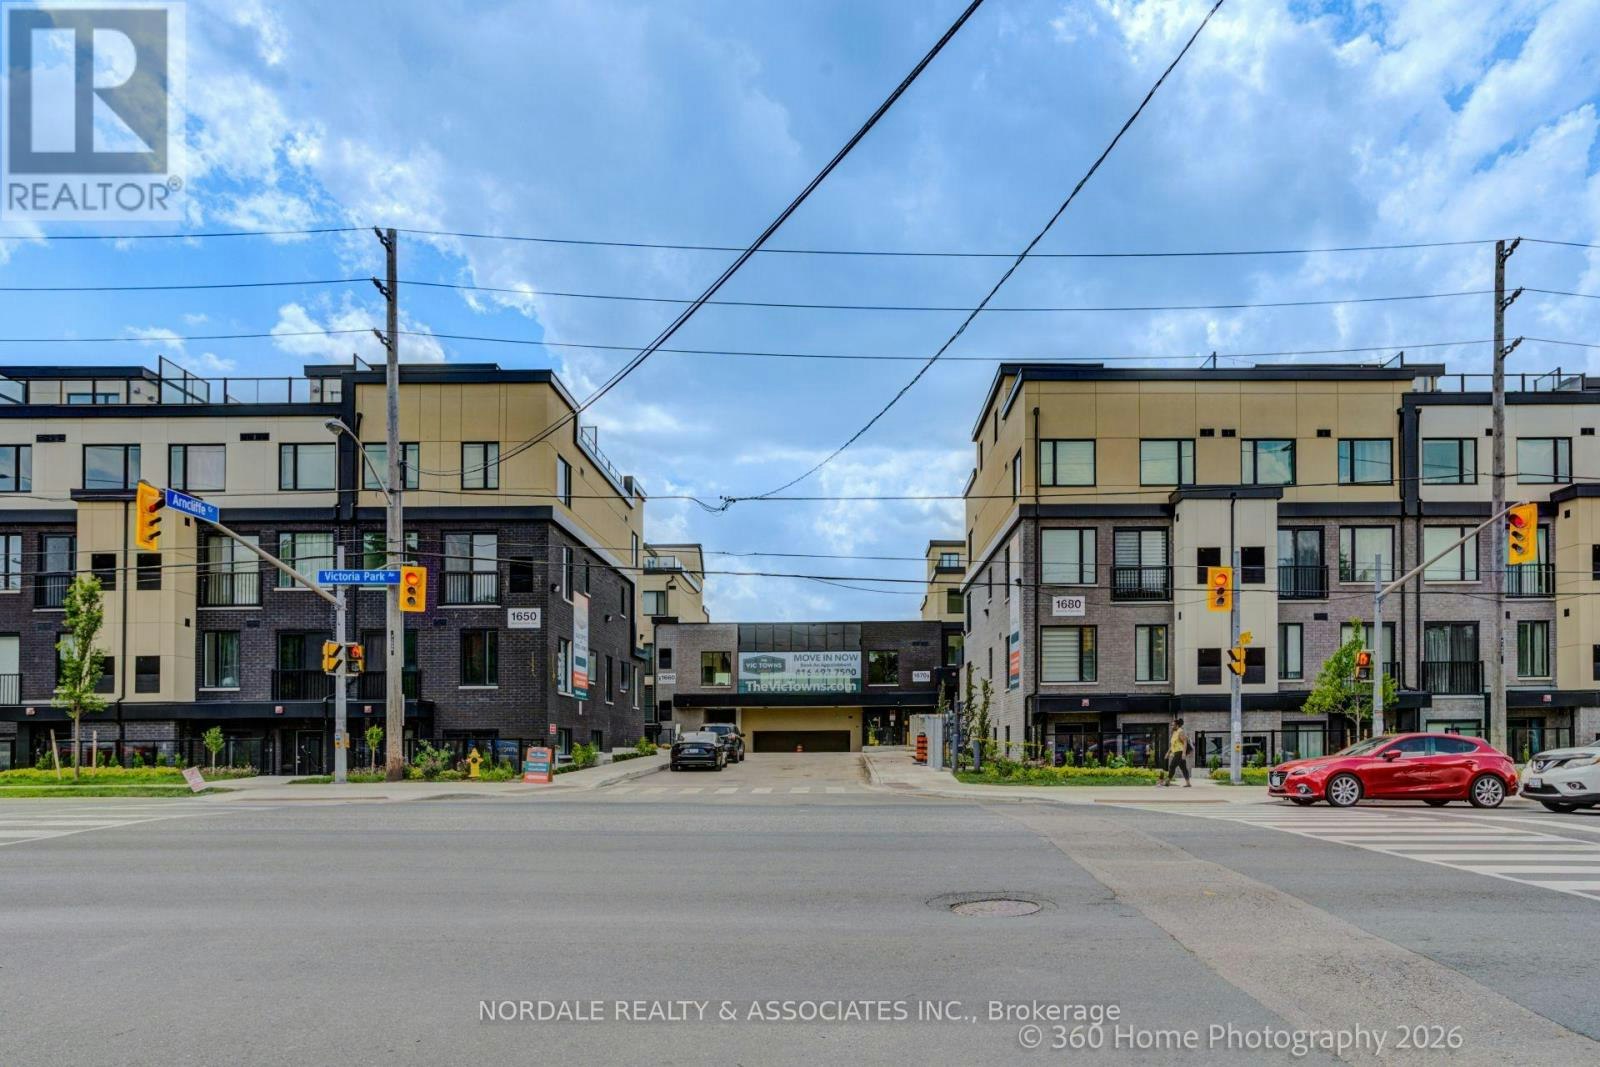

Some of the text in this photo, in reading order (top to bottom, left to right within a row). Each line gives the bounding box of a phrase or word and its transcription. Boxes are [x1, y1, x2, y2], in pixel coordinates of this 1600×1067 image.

[172, 494, 206, 515] Arncliffe
[324, 571, 360, 582] Victoria
[363, 571, 385, 582] Park
[1056, 599, 1082, 609] 1680
[511, 611, 537, 621] 1650
[793, 653, 858, 662] MOVE IN NOW
[745, 680, 857, 692] TheVicTowns.com
